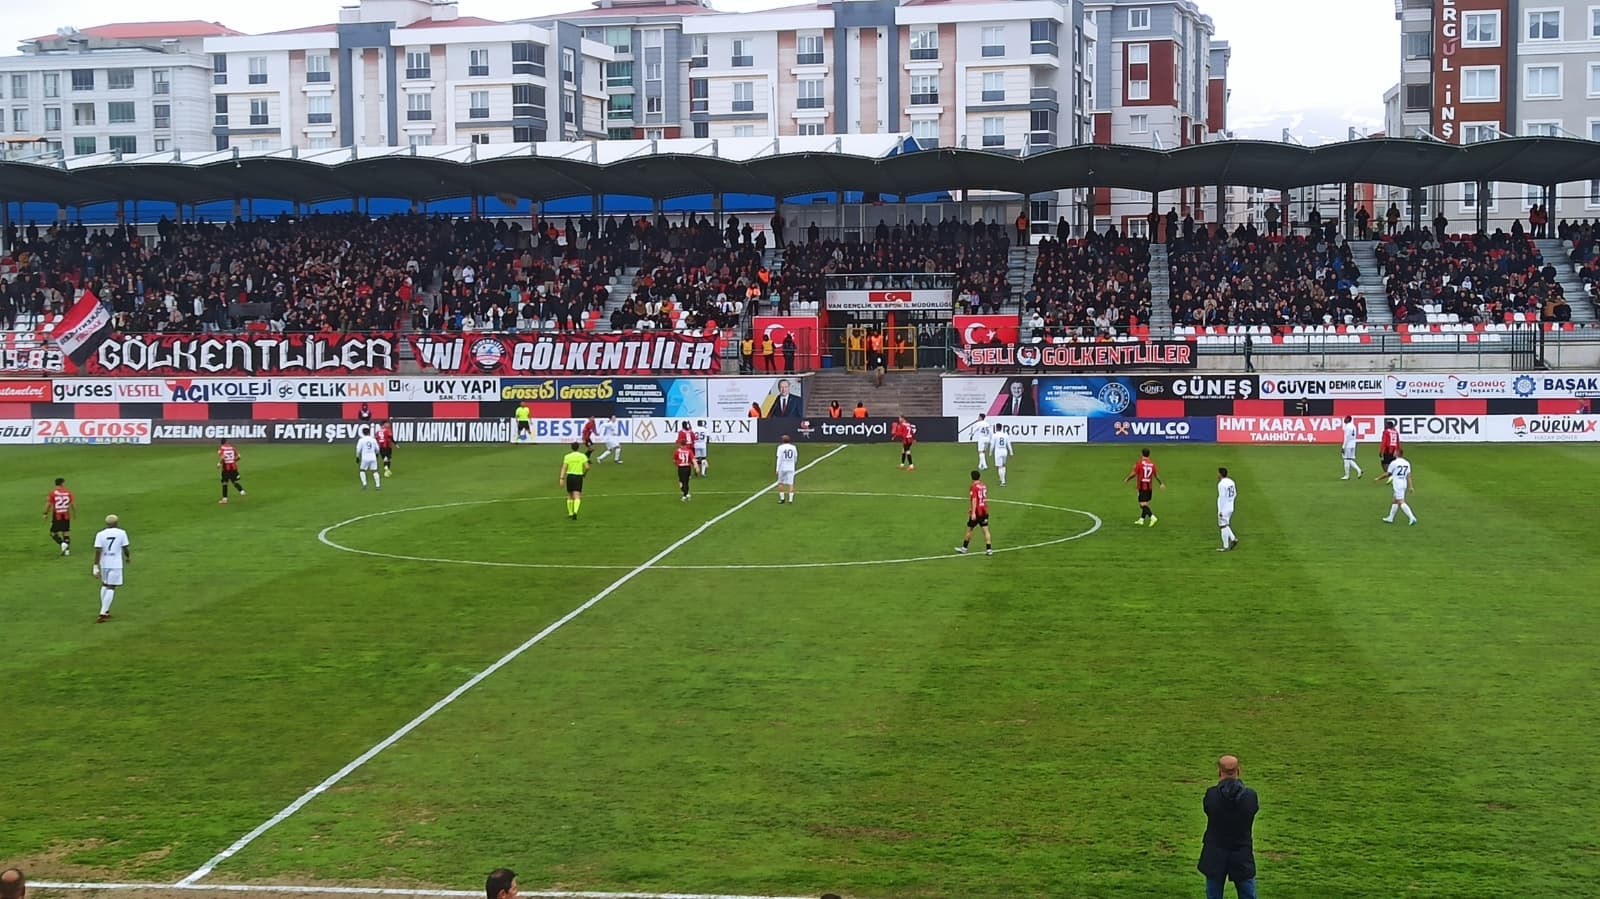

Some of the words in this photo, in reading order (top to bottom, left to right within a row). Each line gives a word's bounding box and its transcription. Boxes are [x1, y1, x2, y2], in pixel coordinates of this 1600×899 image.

[98, 334, 393, 371] GÖLKENTLİLER
[512, 336, 714, 371] GÖLKENTLİLER
[1042, 341, 1191, 366] GÖLKENTLİLER
[118, 384, 162, 397] VESTEL
[172, 384, 209, 402] AÇI
[211, 379, 272, 396] KOLEJİ
[424, 380, 456, 394] UKY
[461, 380, 497, 394] YAPI
[1172, 376, 1253, 400] GÜNEŞ
[1543, 378, 1598, 394] BAŞAK
[0, 425, 32, 437] ÖLÜ
[37, 421, 69, 436] 2A
[80, 421, 148, 436] Gross
[392, 422, 414, 441] VAN
[416, 422, 466, 441] KAHVALTI
[469, 419, 510, 442] KONAĞI
[537, 420, 586, 436] BEST
[821, 422, 887, 437] trendyol
[1044, 425, 1081, 436] FIRAT
[1131, 422, 1190, 435] WILCO
[1219, 417, 1256, 431] HMT
[1259, 417, 1305, 431] KARA
[1250, 432, 1296, 441] TAAHHÜT
[783, 448, 793, 459] 10
[1396, 465, 1409, 476] 27
[54, 496, 71, 509] 22
[106, 536, 116, 551] 7
